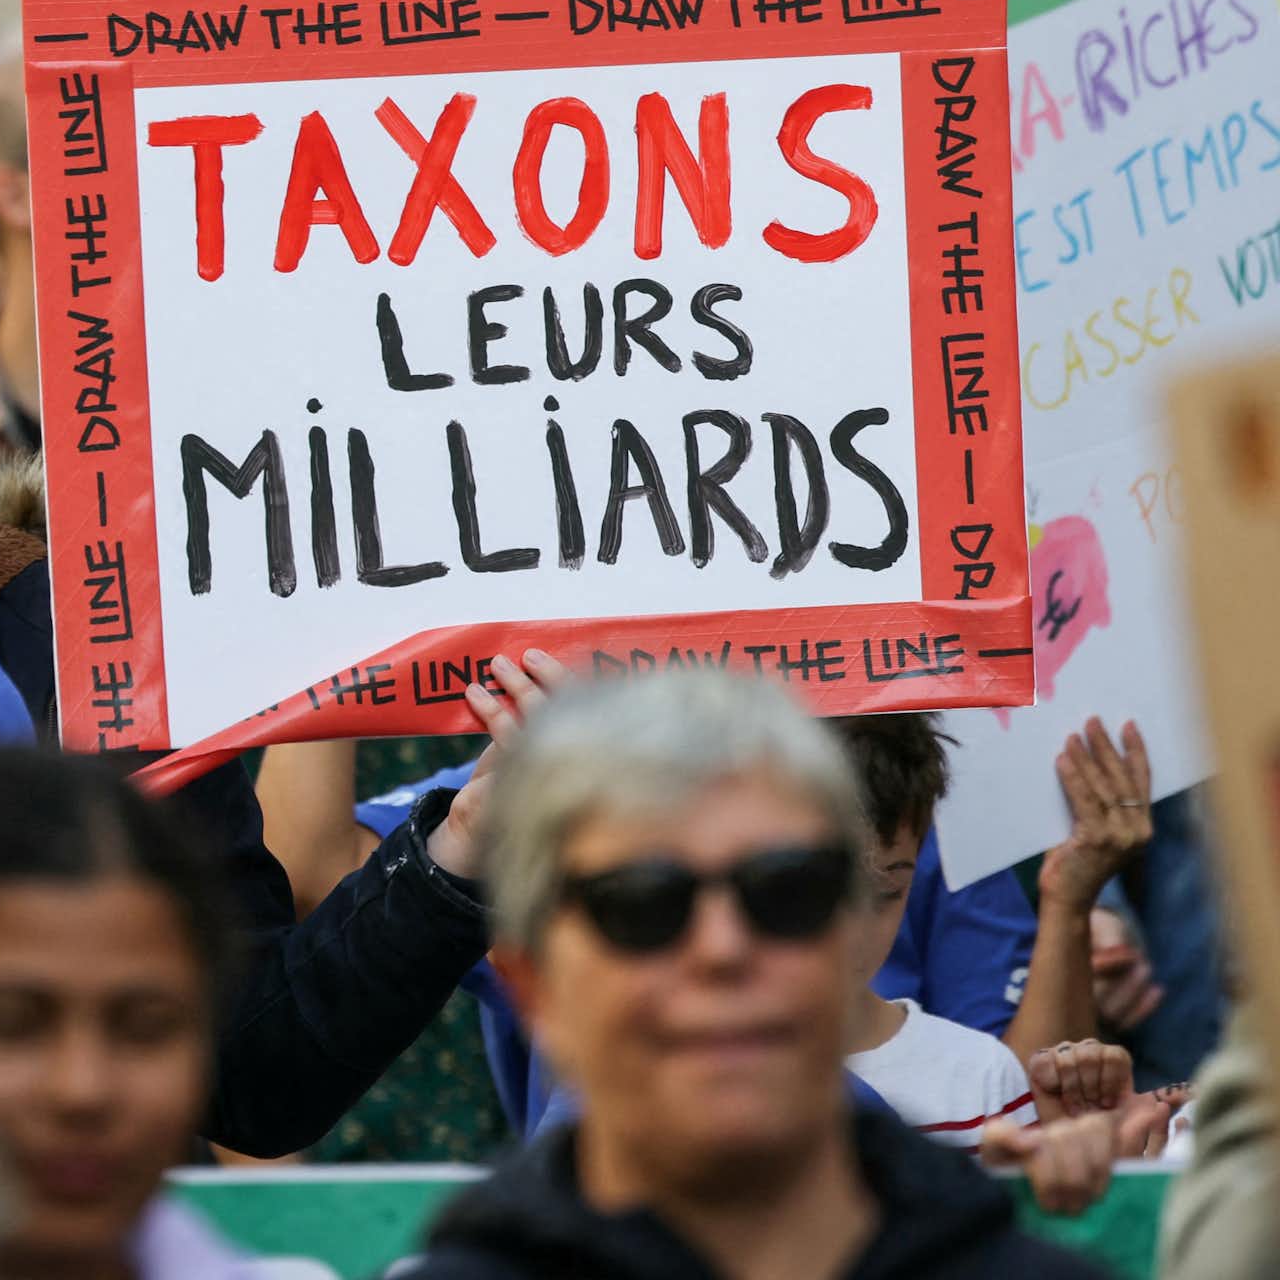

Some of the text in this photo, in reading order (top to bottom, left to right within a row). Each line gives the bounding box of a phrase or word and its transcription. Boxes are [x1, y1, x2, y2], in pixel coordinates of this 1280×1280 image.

[107, 4, 247, 56] DRAW
[260, 2, 362, 49] THE
[147, 83, 879, 282] TAXONS
[1015, 99, 1280, 293] EST TEMPS
[375, 278, 754, 392] LEURS
[931, 57, 995, 600] DRAW THE LINE DR
[1024, 267, 1201, 410] CASSER
[59, 73, 139, 753] THE LINE DRAW THE LINE
[744, 639, 846, 683] THE
[864, 633, 965, 683] LINE
